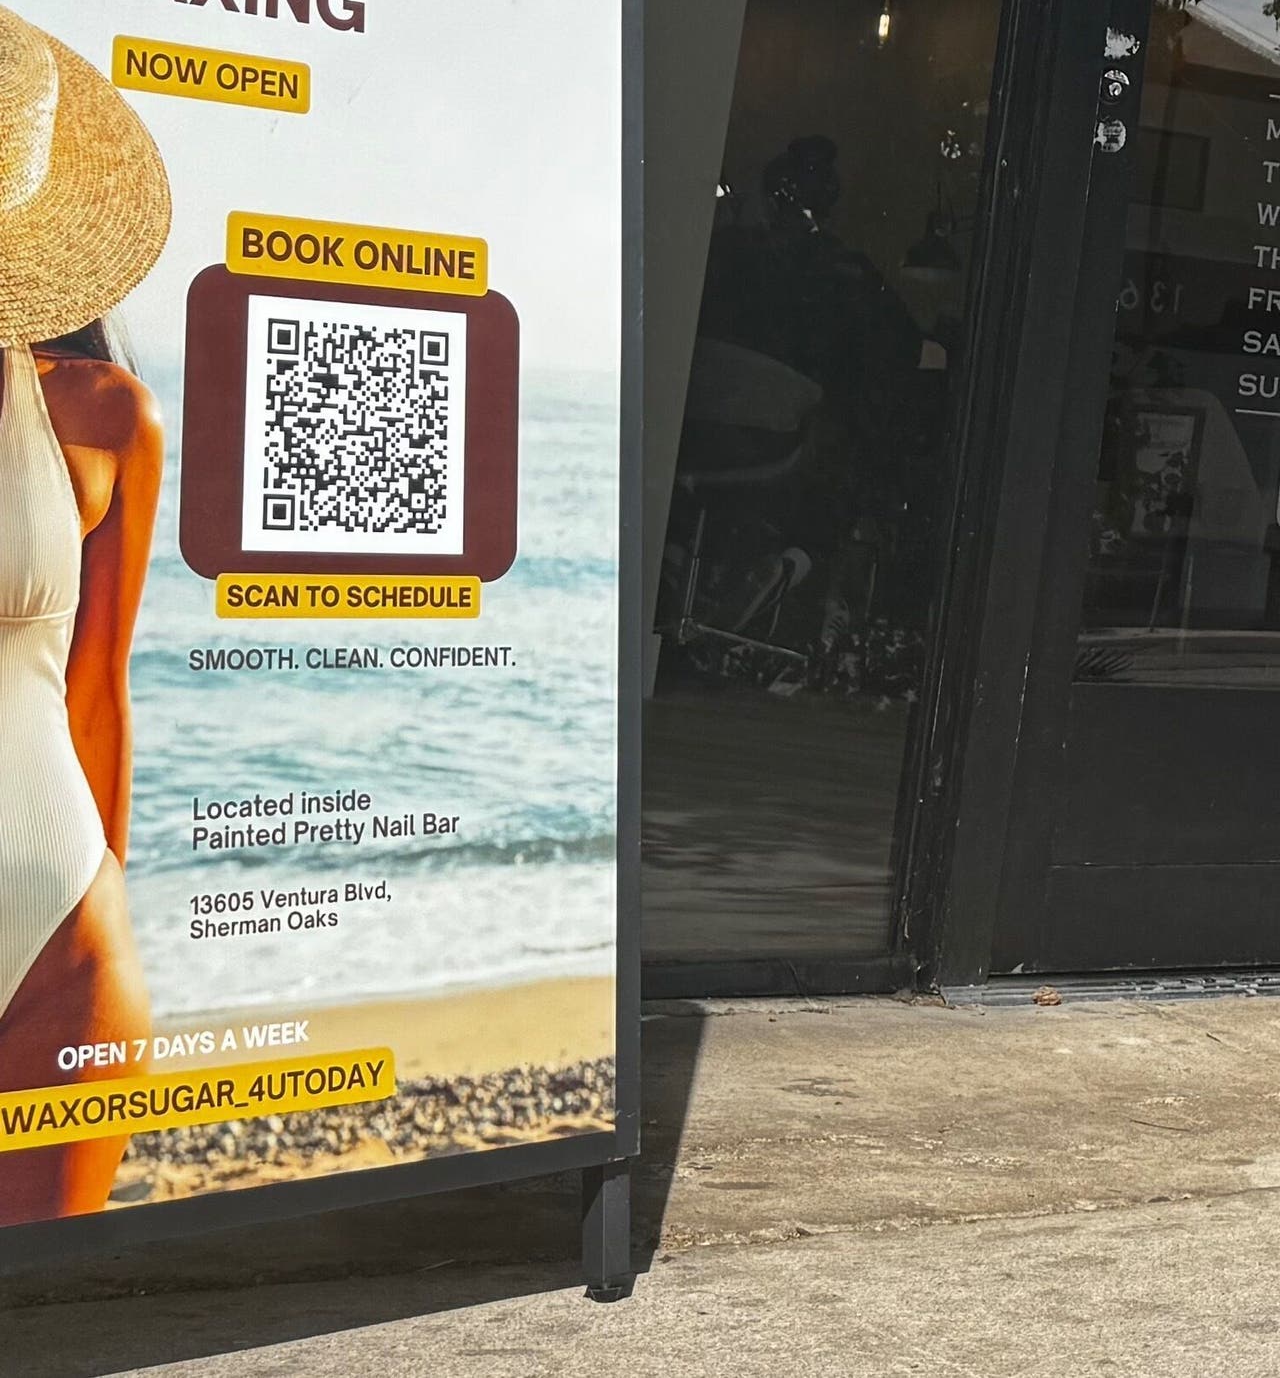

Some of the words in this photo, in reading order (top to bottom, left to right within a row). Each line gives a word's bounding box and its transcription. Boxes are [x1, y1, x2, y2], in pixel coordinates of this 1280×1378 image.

[126, 49, 206, 87] NOW
[216, 62, 299, 99] OPEN
[242, 228, 345, 270] BOOK
[354, 241, 475, 279] ONLINE
[227, 584, 299, 608] SCAN
[306, 584, 340, 608] TO
[347, 584, 472, 609] SCHEDULE
[189, 649, 299, 671] SMOOTH.
[305, 648, 383, 670] CLEAN.
[390, 646, 516, 669] CONFIDENT.
[193, 792, 294, 821] Located
[301, 789, 371, 815] inside
[193, 825, 286, 850] Painted
[294, 819, 364, 846] Pretty
[373, 814, 415, 837] Nail
[422, 813, 460, 835] Bar
[190, 889, 254, 915] 13605
[260, 886, 338, 909] Ventura
[344, 881, 392, 905] Blvd,
[190, 917, 281, 939] Sherman
[287, 910, 338, 931] Oaks
[57, 1042, 126, 1071] OPEN
[134, 1039, 147, 1061] 7
[153, 1031, 215, 1060] DAYS
[221, 1029, 236, 1052] A
[243, 1021, 309, 1048] WEEK
[1, 1059, 386, 1135] WAXORSUGAR_4UTODAY
